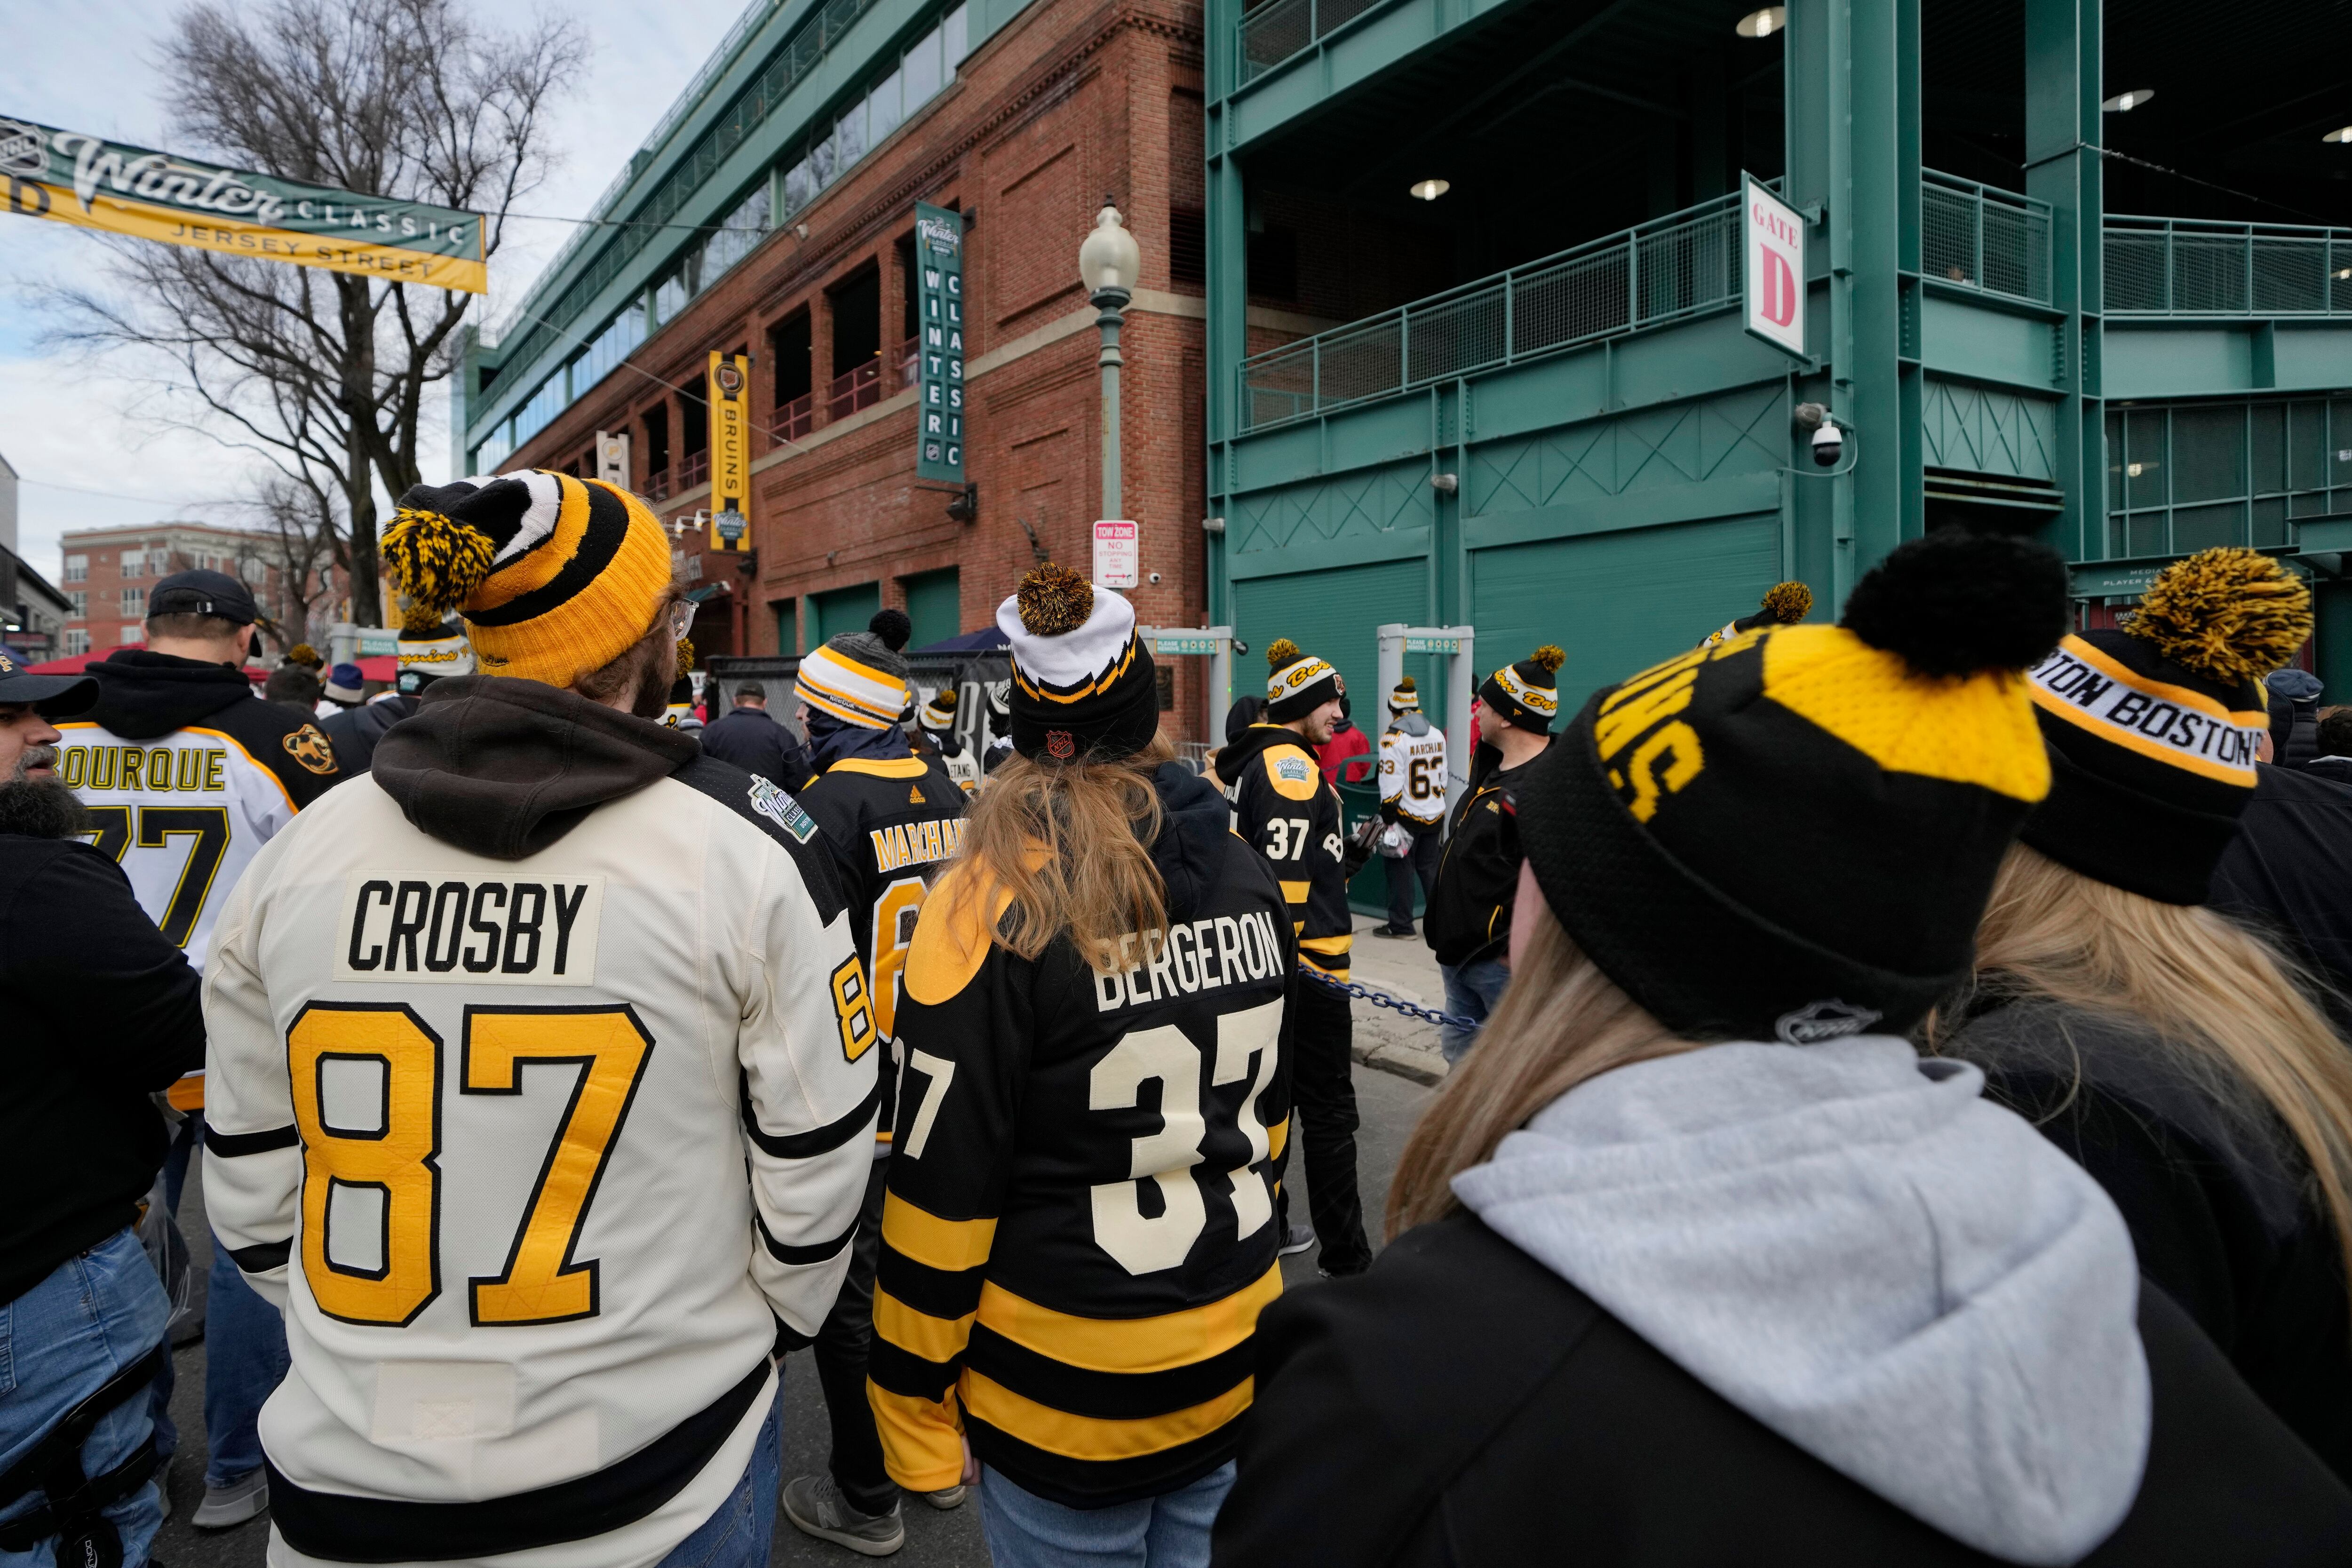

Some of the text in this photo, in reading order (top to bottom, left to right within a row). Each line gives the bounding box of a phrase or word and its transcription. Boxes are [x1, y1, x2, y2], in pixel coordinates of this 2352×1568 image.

[52, 132, 463, 245] Winter CLASSIC
[1753, 203, 1797, 249] GATE
[170, 223, 432, 278] JERSEY STREET
[1760, 242, 1796, 327] D
[926, 270, 941, 433] WINTER
[948, 276, 962, 465] CLASSIC
[725, 409, 738, 490] BRUINS
[1097, 526, 1133, 537] TOW ZONE
[1054, 738, 1068, 752] NHL
[1276, 762, 1309, 774] Winter
[2105, 692, 2251, 766] BOSTON
[1266, 818, 1310, 861] 37
[348, 880, 588, 975] CROSBY
[1092, 911, 1284, 1012] BERGERON
[286, 1000, 657, 1329] 87
[1089, 994, 1285, 1276] 37
